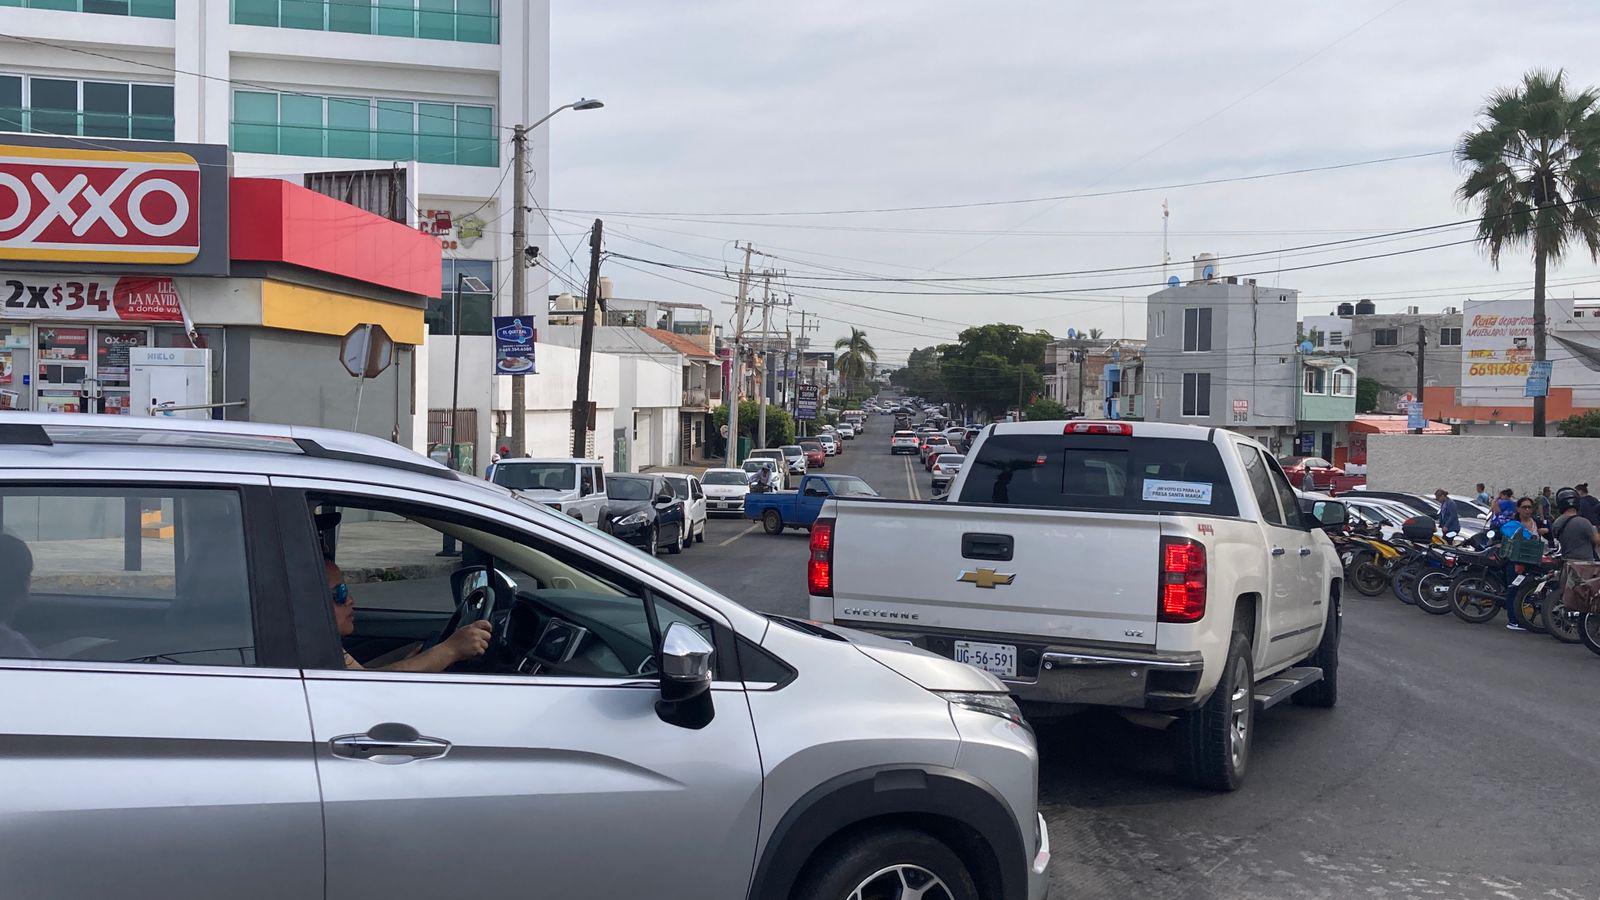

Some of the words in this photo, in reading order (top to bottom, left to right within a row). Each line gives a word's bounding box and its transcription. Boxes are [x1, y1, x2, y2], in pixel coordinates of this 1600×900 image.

[128, 293, 144, 305] LA
[136, 305, 164, 313] donde
[844, 607, 919, 620] CHEYENNE
[1124, 629, 1143, 638] LTZ
[956, 648, 1013, 668] UG-56-591
